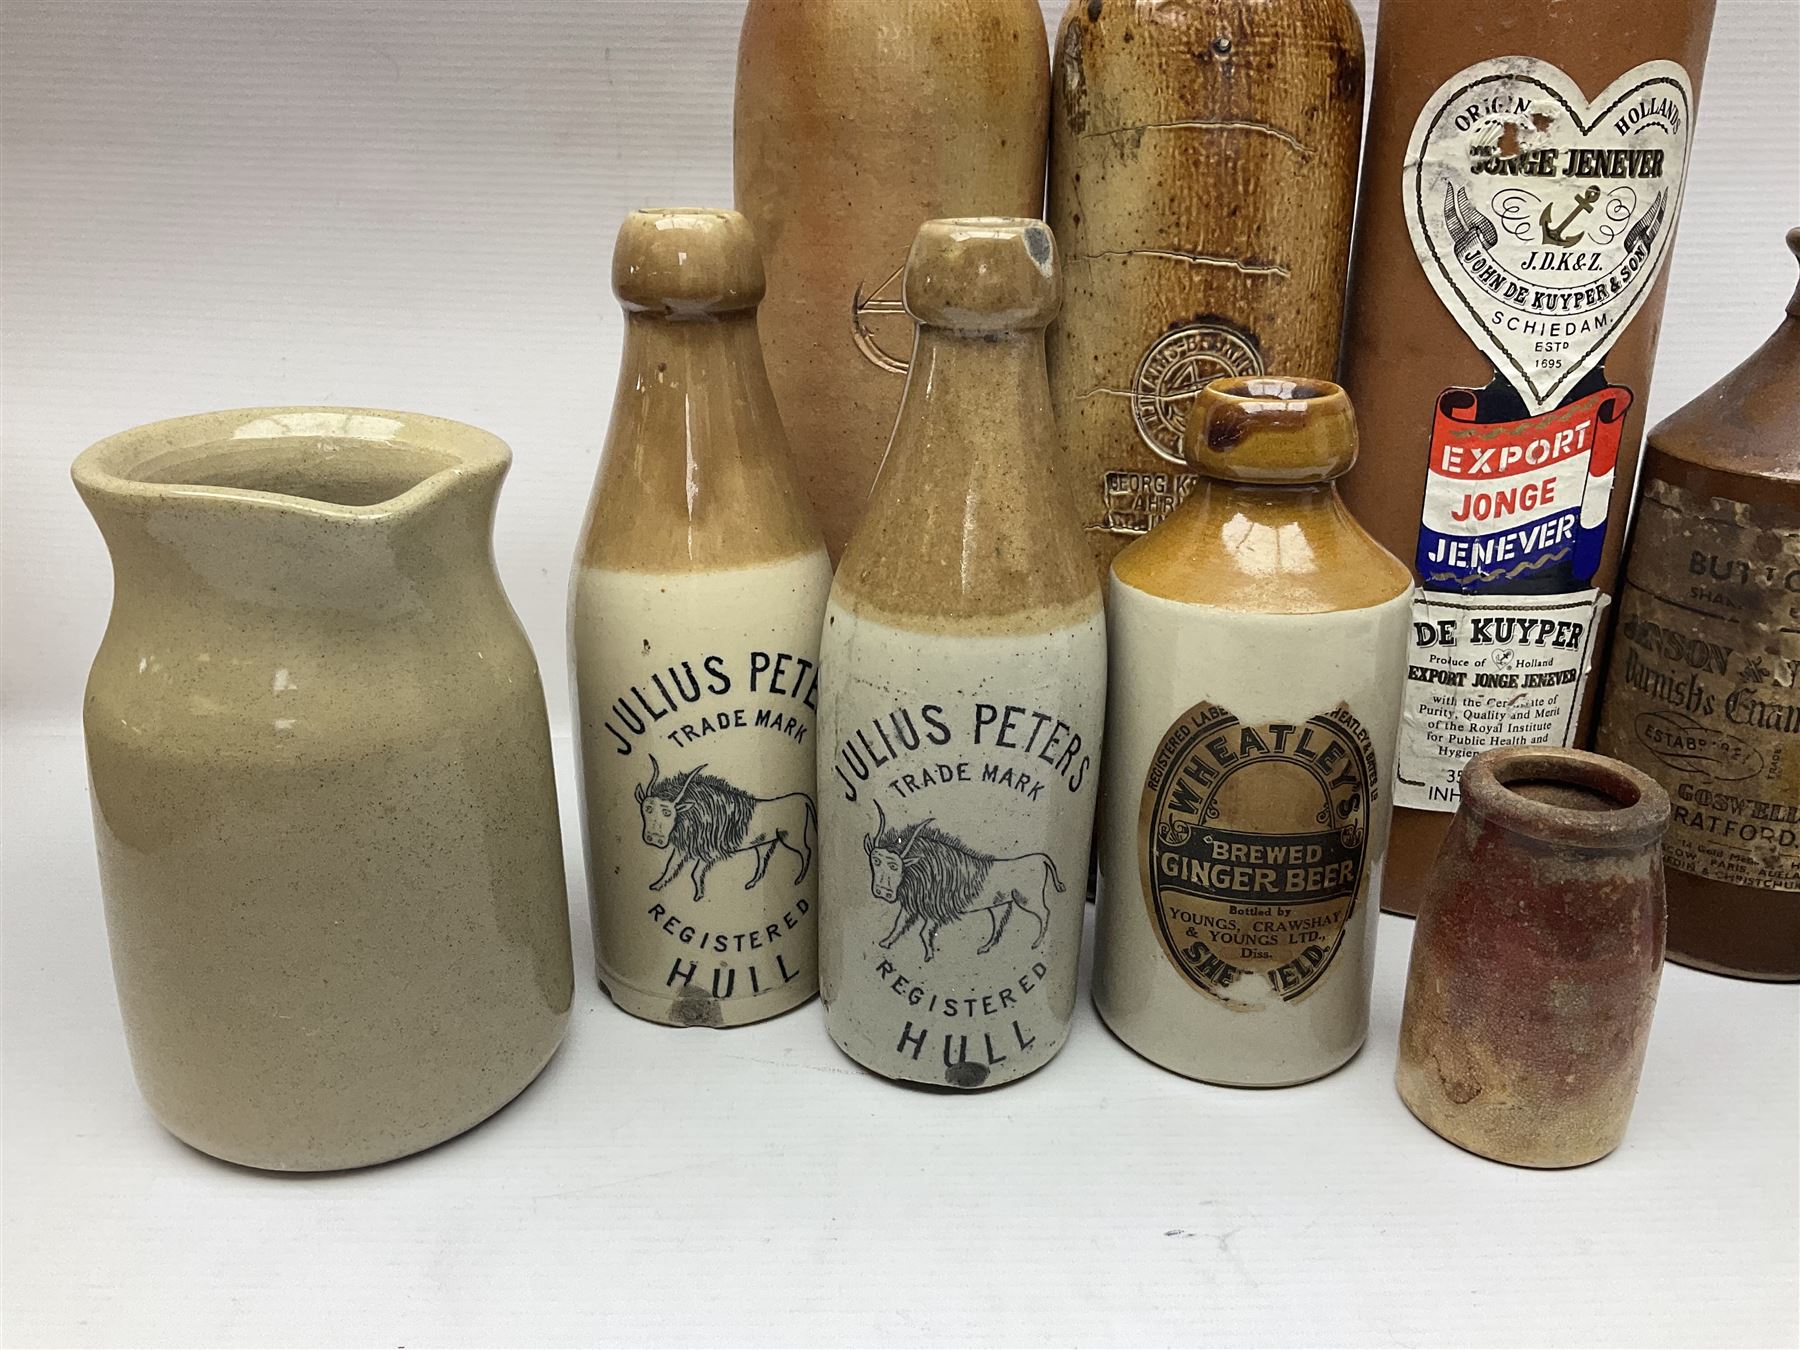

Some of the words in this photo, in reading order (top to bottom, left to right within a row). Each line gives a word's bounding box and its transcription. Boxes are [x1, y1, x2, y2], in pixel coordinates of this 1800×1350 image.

[1614, 98, 1681, 136] HOLLANDS
[1562, 149, 1664, 178] JENEVER
[1465, 249, 1504, 291] JOHN
[1504, 280, 1529, 305] DE
[1532, 284, 1609, 311] KUYPER
[1609, 280, 1622, 293] &
[1622, 244, 1647, 284] SON
[1491, 312, 1614, 337] SCHIEDAM.
[1535, 359, 1562, 369] 1695
[1442, 420, 1591, 473] EXPORT
[1452, 477, 1557, 522] JONGE
[1428, 514, 1575, 569] JENEVER
[1414, 620, 1457, 648] DE
[1470, 617, 1584, 651] KUYPER
[1408, 665, 1467, 687] EXPORT
[1472, 673, 1518, 689] JONGE
[1521, 668, 1577, 689] JENEVER
[1429, 655, 1469, 667] Produce
[1474, 658, 1487, 668] of
[1516, 657, 1554, 668] Holland
[604, 655, 731, 756] JULIUS
[1433, 695, 1457, 706] with
[1463, 697, 1481, 707] the
[1547, 694, 1559, 705] of
[1464, 709, 1506, 722] Quality
[1510, 710, 1530, 720] and
[1535, 707, 1561, 719] Merit
[668, 709, 747, 748] TRADE
[755, 710, 807, 744] MARK
[1325, 707, 1370, 743] HEATLEY
[1427, 731, 1443, 743] for
[1448, 734, 1486, 746] Public
[1490, 736, 1526, 746] Health
[1531, 733, 1549, 744] and
[1428, 720, 1441, 730] of
[1444, 721, 1464, 732] the
[1469, 723, 1502, 733] Royal
[1508, 722, 1552, 733] Institute
[835, 704, 951, 802] JULIUS
[974, 703, 1090, 792] PETERS
[1147, 724, 1191, 792] REGISTERED
[1191, 705, 1229, 728] LABE
[889, 762, 971, 798] TRADE
[982, 763, 1045, 801] MARK
[1168, 723, 1361, 819] WHEATLEY'S
[1212, 840, 1323, 864] BREWED
[1160, 852, 1280, 893] GINGER
[1285, 860, 1355, 893] BEER
[648, 898, 810, 953] REGISTERED
[1169, 907, 1241, 933] YOUNGS,
[1253, 910, 1342, 933] CRAWSHAY
[1229, 905, 1271, 917] Bottled
[1277, 906, 1291, 918] by
[1185, 926, 1198, 938] &
[1209, 930, 1279, 945] YOUNGS
[1240, 948, 1273, 959] Diss.
[876, 960, 1048, 1017] REGISTERED
[897, 1020, 1036, 1068] HULL
